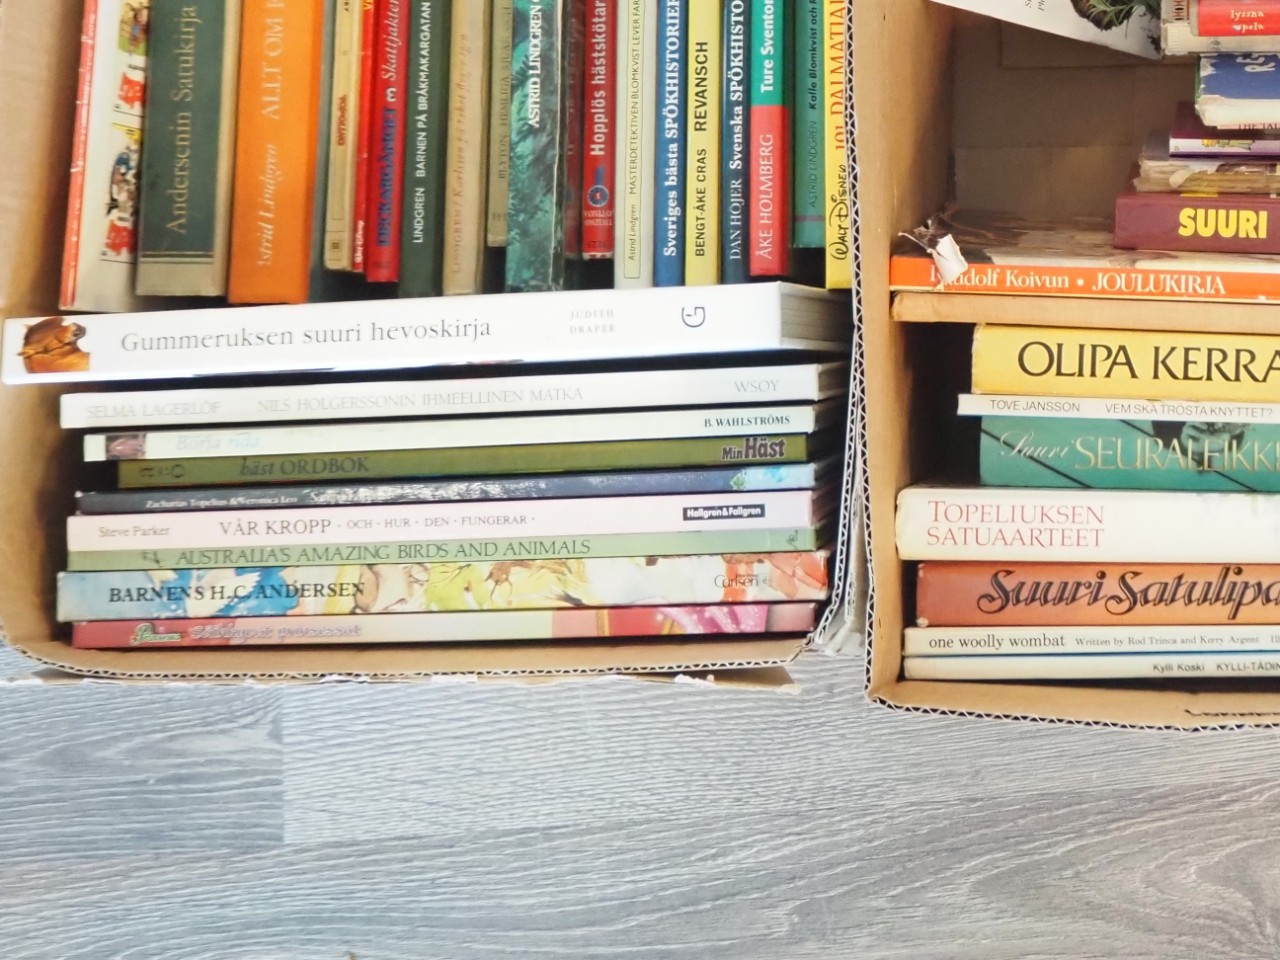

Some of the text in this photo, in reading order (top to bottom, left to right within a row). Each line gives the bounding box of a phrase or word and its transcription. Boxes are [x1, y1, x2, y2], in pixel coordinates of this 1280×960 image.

[529, 5, 542, 75] LINDGREN
[760, 58, 774, 93] Ture
[166, 5, 203, 235] Andersenin Satukirja
[413, 1, 432, 243] LINDGREN BARNEN PÅ BRÅKMAKARGATAN
[528, 78, 540, 128] ASTRID
[590, 91, 607, 156] Hopplös
[694, 41, 709, 257] BENGT-ÅKE CRAS REVANSCH
[729, 106, 743, 170] Svenska
[665, 142, 678, 188] bästa
[760, 133, 773, 222] HOLMBERG
[664, 191, 681, 256] Sveriges
[729, 178, 746, 228] HÖJER
[1178, 207, 1268, 239] SUURI
[729, 229, 742, 260] DAN
[757, 225, 773, 260] ÅKE
[1006, 270, 1069, 289] Koivun
[1092, 272, 1226, 296] JOULUKIRJA
[121, 308, 615, 352] Gummeruksen suuri hevoskirja JUDITH
[570, 324, 615, 335] DRAPER
[1017, 341, 1140, 380] OLIPA
[87, 379, 780, 420] SELMA LAGERLÖF NILS HOLGERSSONIN IHMEELLINEN MATKA WSOY
[990, 399, 1021, 411] TOVE
[1022, 399, 1080, 413] JANSSON
[1105, 403, 1132, 415] VEM
[1161, 402, 1209, 416] TRÖSTA
[1210, 405, 1273, 418] KNYTTET?
[98, 525, 129, 538] Steve
[131, 524, 170, 538] Parker
[219, 518, 259, 536] VÅR
[265, 519, 331, 535] KROPP
[346, 518, 373, 530] OCH
[384, 518, 411, 530] HUR
[424, 515, 450, 528] DEN
[461, 514, 528, 526] FUNGERAR
[928, 500, 1104, 524] TOPELIUKSEN
[299, 544, 390, 562] AMAZING
[398, 542, 449, 559] BIRDS
[455, 541, 499, 557] AND
[503, 539, 591, 556] ANIMALS
[927, 527, 1105, 548] SATUAARTEET
[977, 569, 1108, 615] Suuri
[1153, 662, 1174, 673] Kylli
[1177, 662, 1205, 672] Koski
